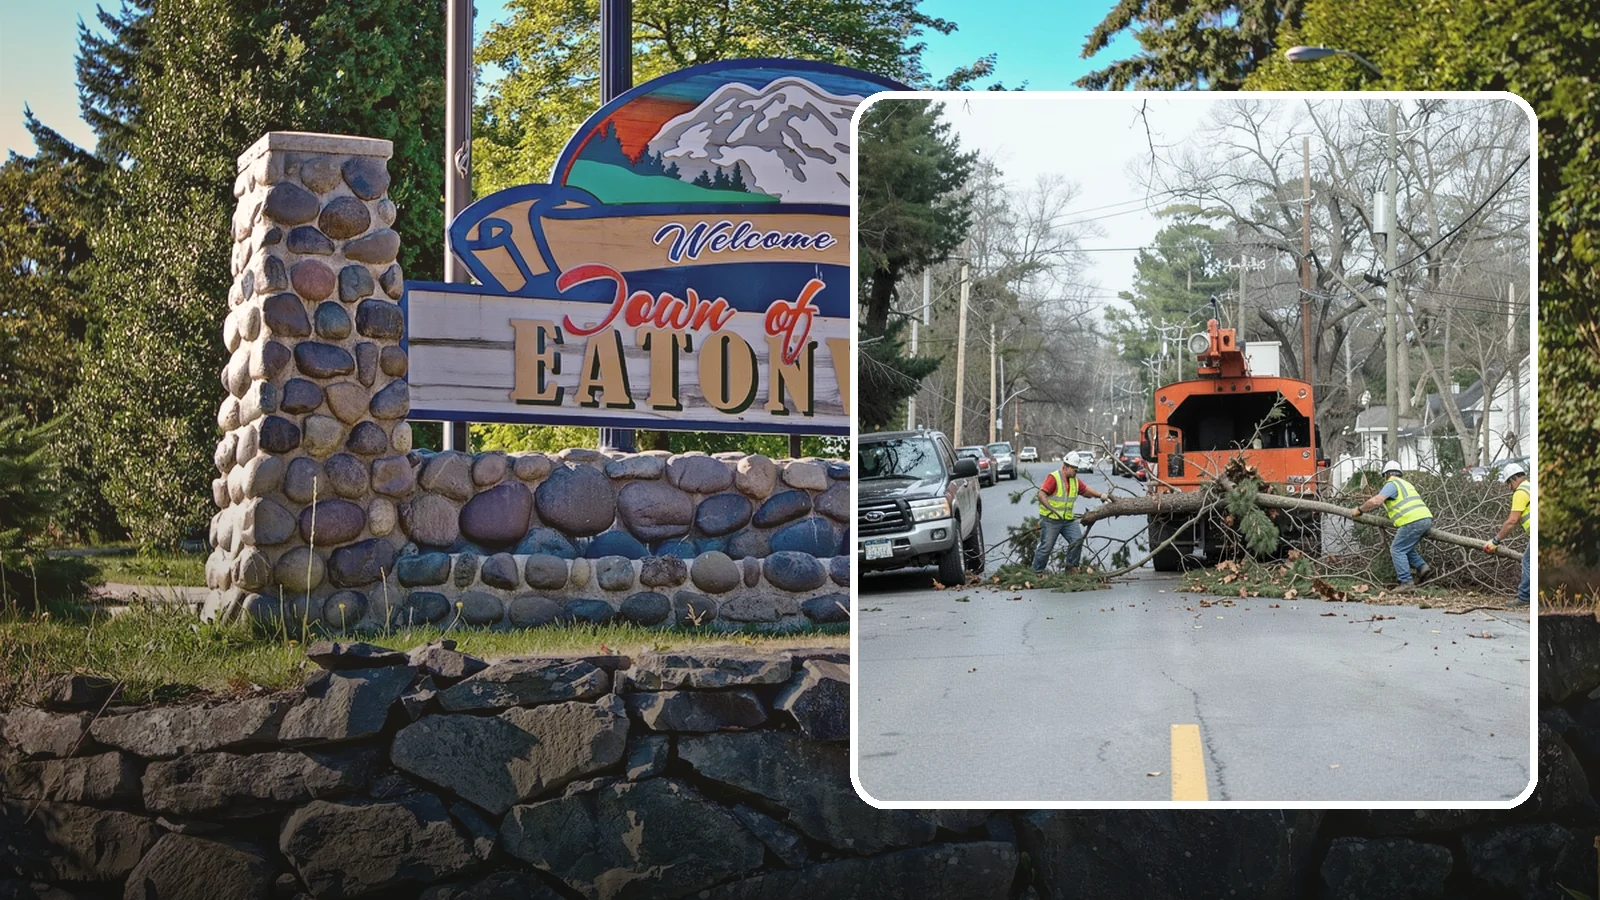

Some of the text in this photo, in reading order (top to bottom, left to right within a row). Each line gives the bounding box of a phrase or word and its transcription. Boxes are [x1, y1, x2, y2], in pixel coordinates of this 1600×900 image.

[653, 220, 837, 263] Welcome
[557, 263, 825, 366] Town of
